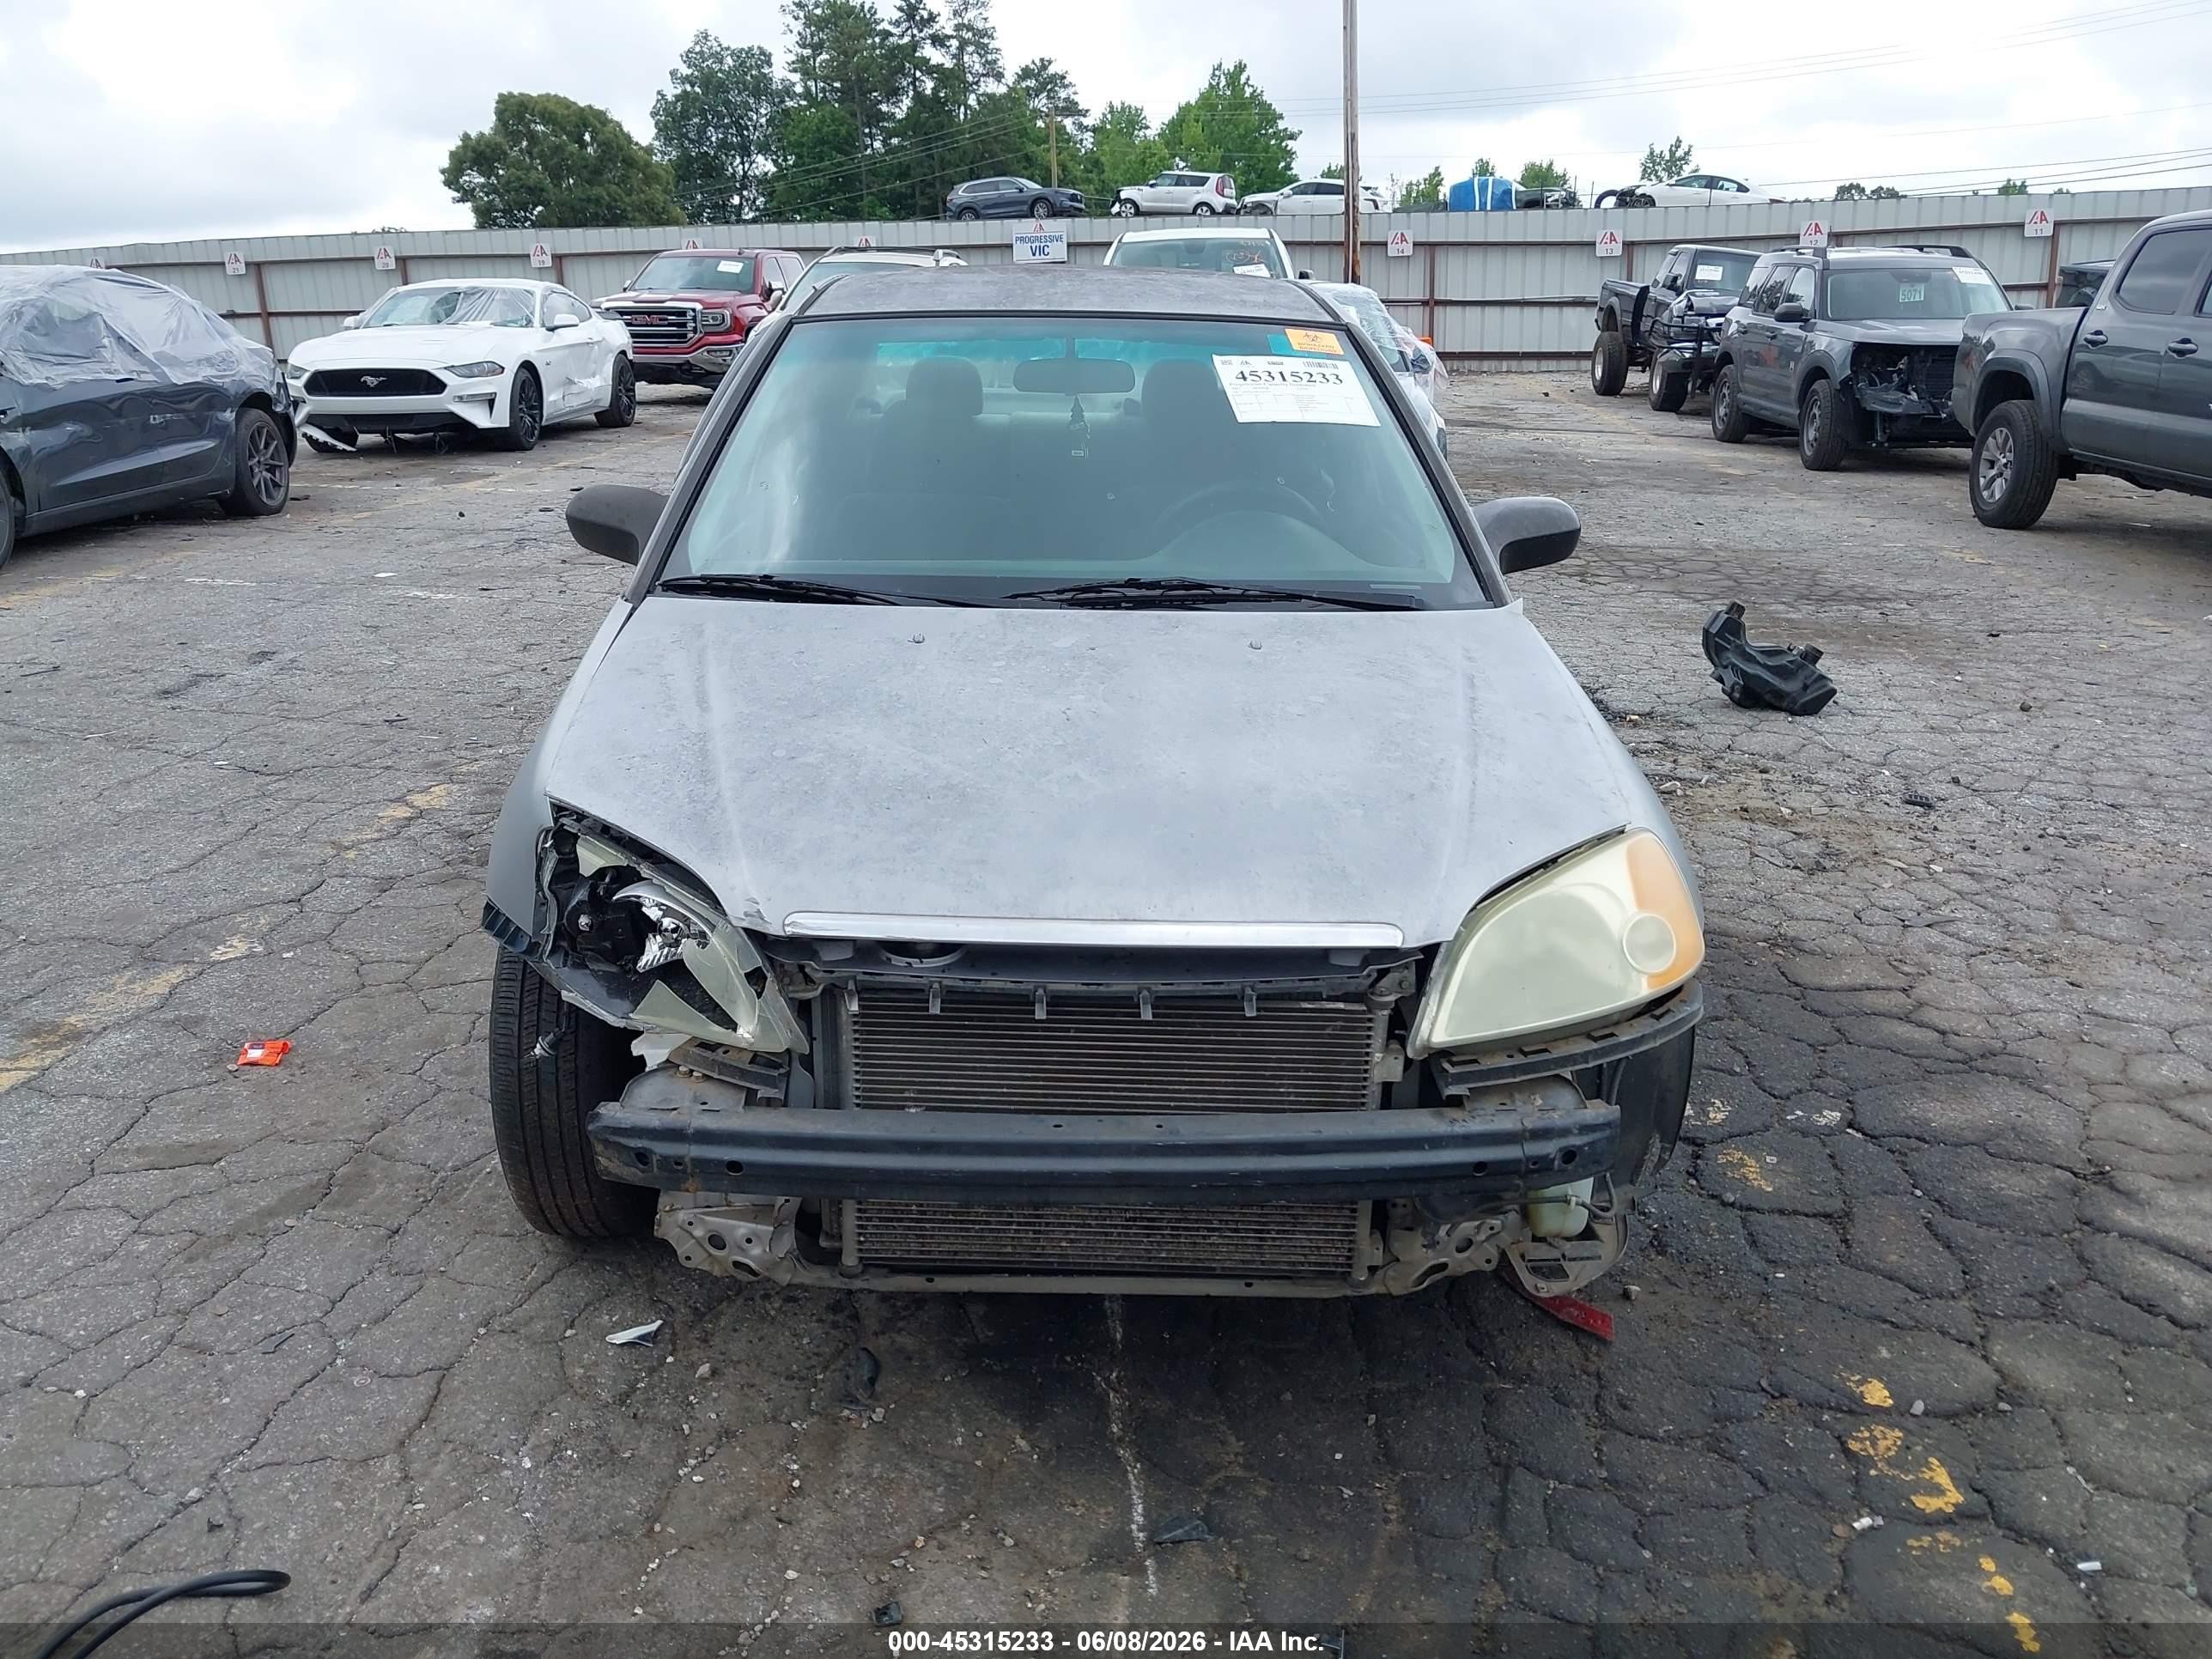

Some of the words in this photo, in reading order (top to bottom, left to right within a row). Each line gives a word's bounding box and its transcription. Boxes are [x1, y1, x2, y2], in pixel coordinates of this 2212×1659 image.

[1015, 234, 1064, 245] PROGRESSIVE
[1030, 244, 1050, 257] VIC
[1900, 288, 1922, 301] 5071
[631, 314, 668, 325] GMC
[1235, 370, 1343, 385] 45315233
